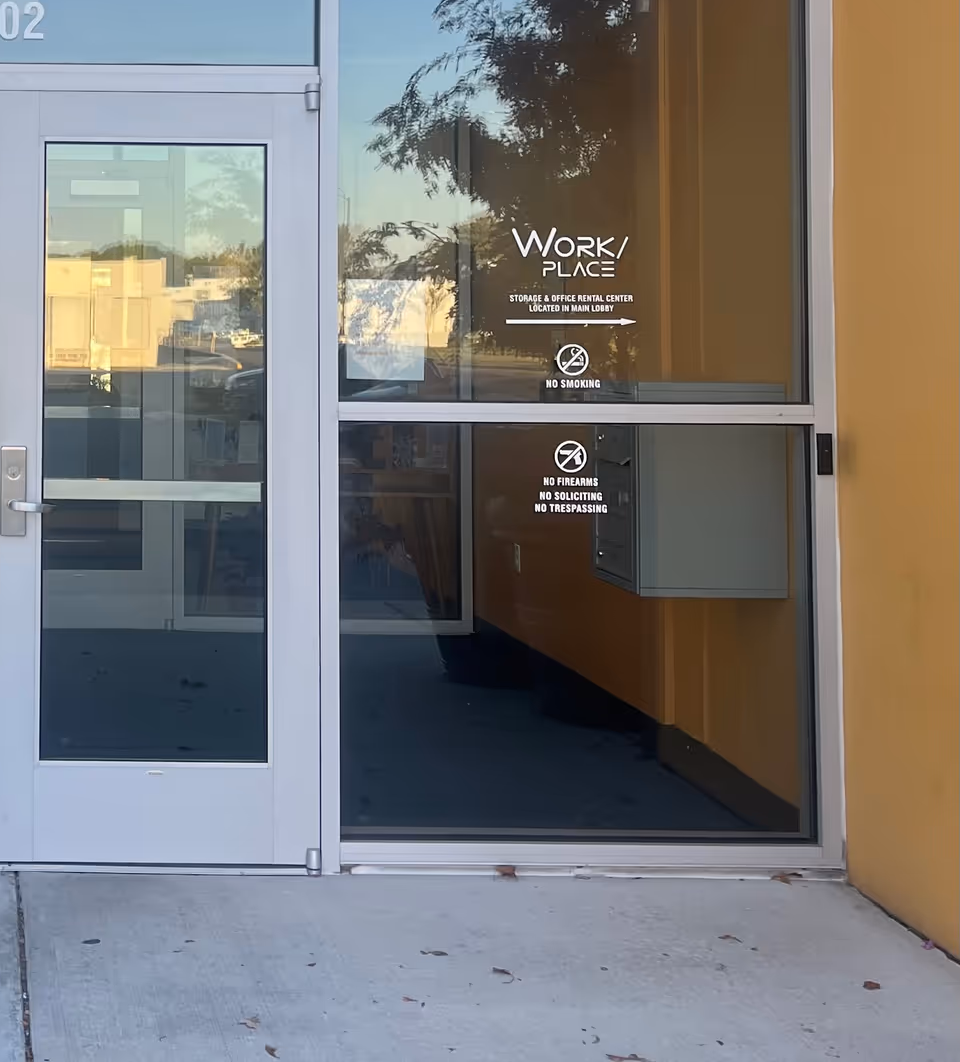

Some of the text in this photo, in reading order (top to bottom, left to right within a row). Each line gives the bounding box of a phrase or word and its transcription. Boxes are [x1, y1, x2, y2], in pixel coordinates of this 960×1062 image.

[543, 261, 615, 277] PLACE
[509, 294, 633, 303] STORAGE & OFFICE RENTAL CENTER
[529, 304, 614, 313] LOCATED IN MAIN LOBBY
[546, 379, 601, 389] NO SMOKING
[543, 477, 598, 487] NO FIREARMS
[539, 491, 603, 502] NO SOLICITING
[534, 503, 608, 514] NO TRESPASSING
